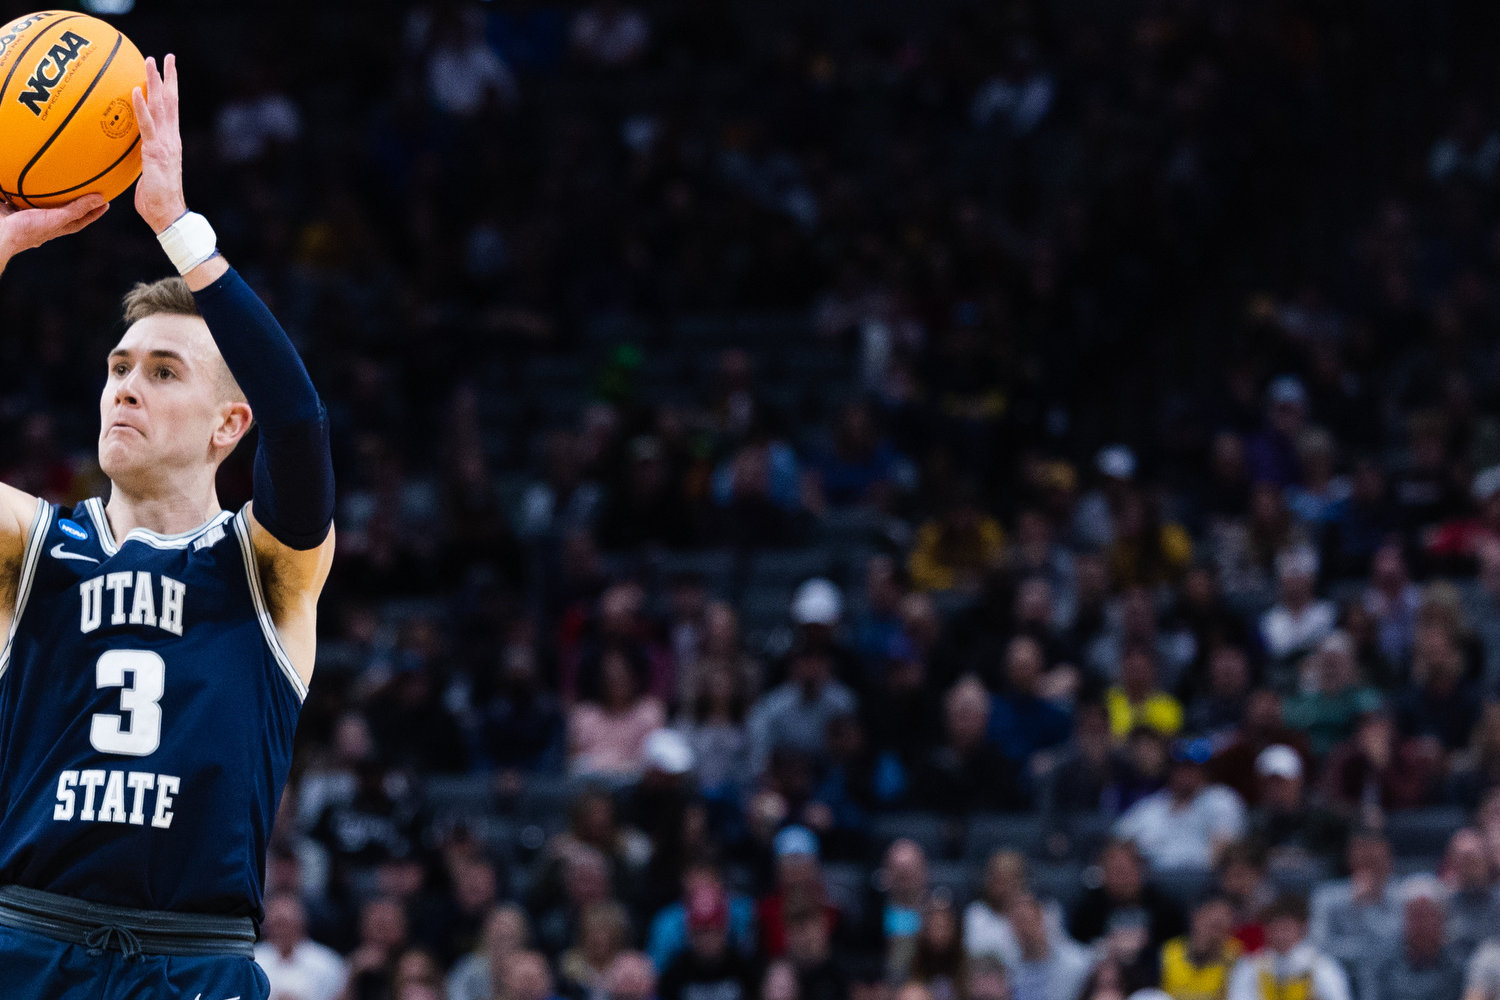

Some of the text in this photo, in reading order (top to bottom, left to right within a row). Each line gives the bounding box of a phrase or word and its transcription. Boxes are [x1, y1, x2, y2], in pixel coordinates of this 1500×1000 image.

[17, 29, 92, 117] NCAA
[61, 523, 87, 540] NCAA
[80, 570, 187, 637] UTAH
[89, 649, 166, 757] 3
[53, 769, 182, 829] STATE
